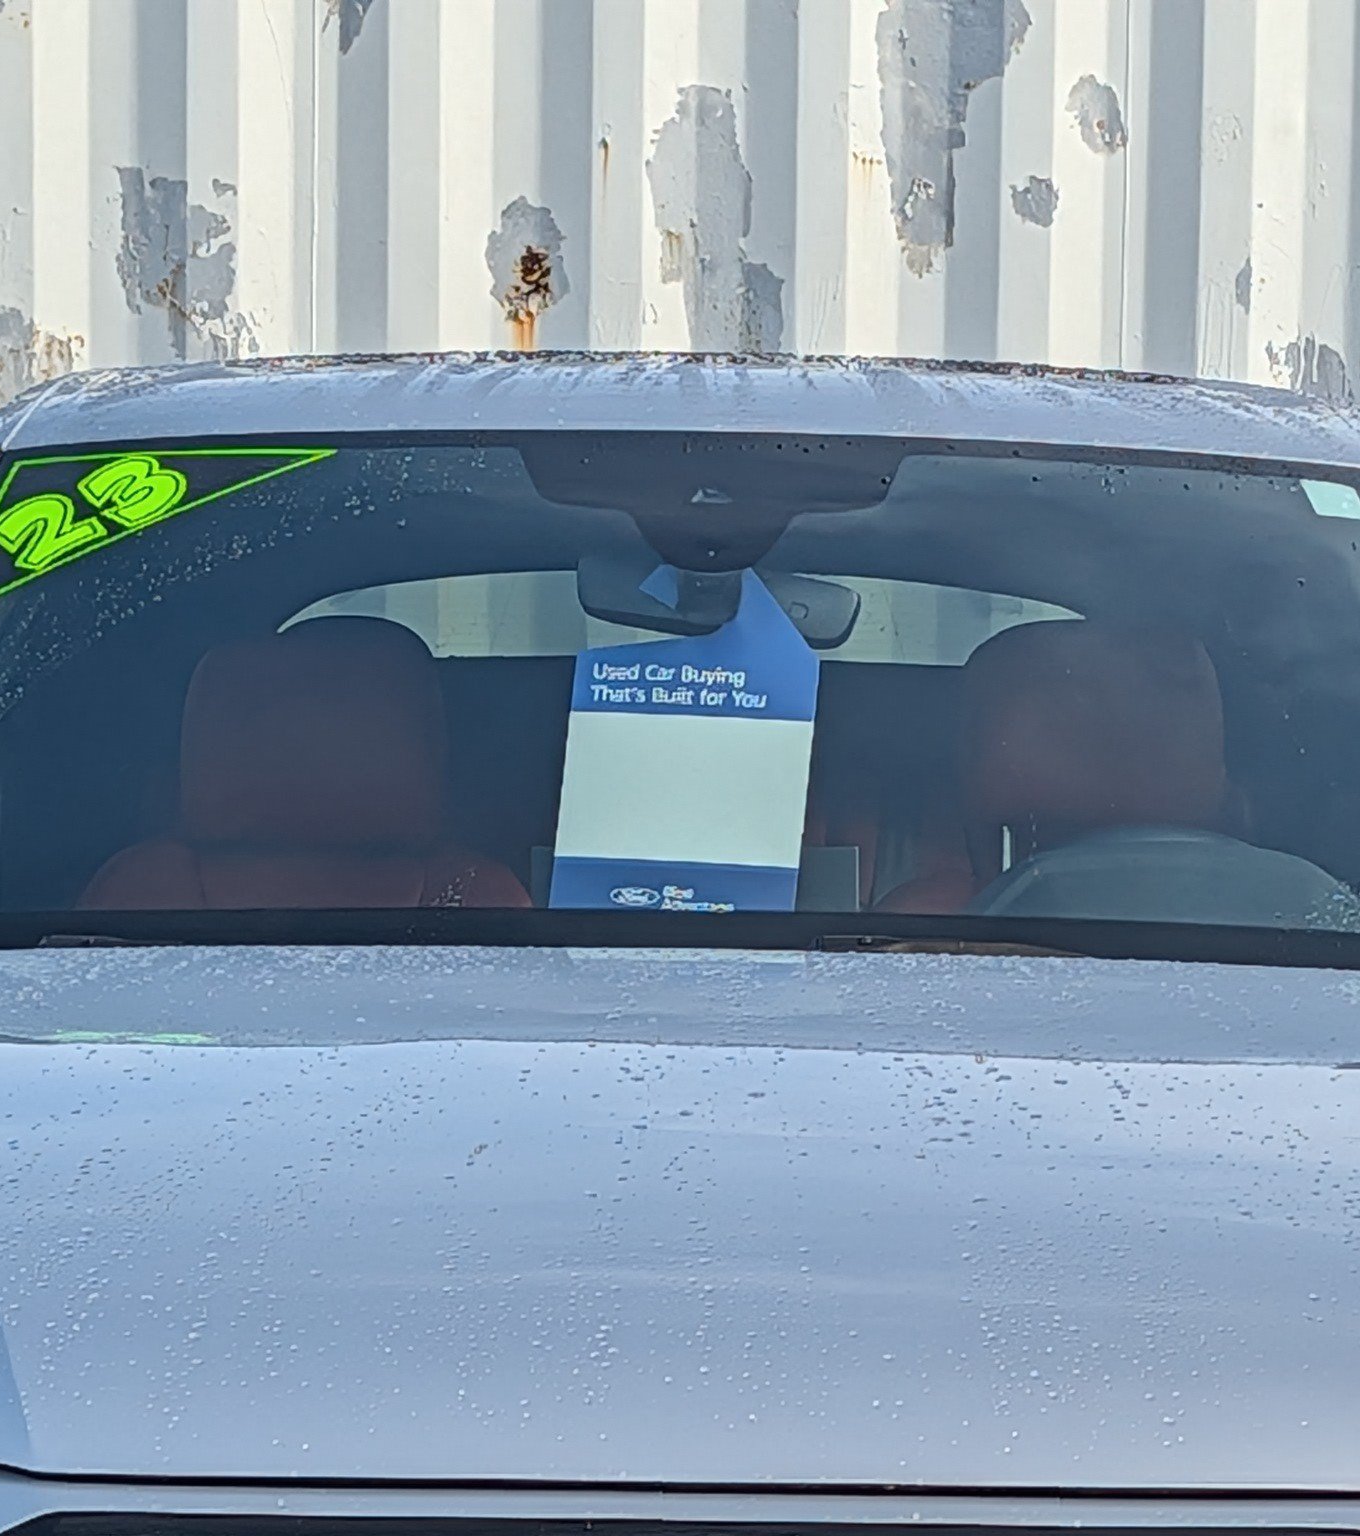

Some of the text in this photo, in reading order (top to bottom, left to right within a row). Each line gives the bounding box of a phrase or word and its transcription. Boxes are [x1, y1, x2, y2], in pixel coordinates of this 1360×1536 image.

[592, 662, 746, 689] Used Car Buying
[590, 684, 768, 709] That's Built for You
